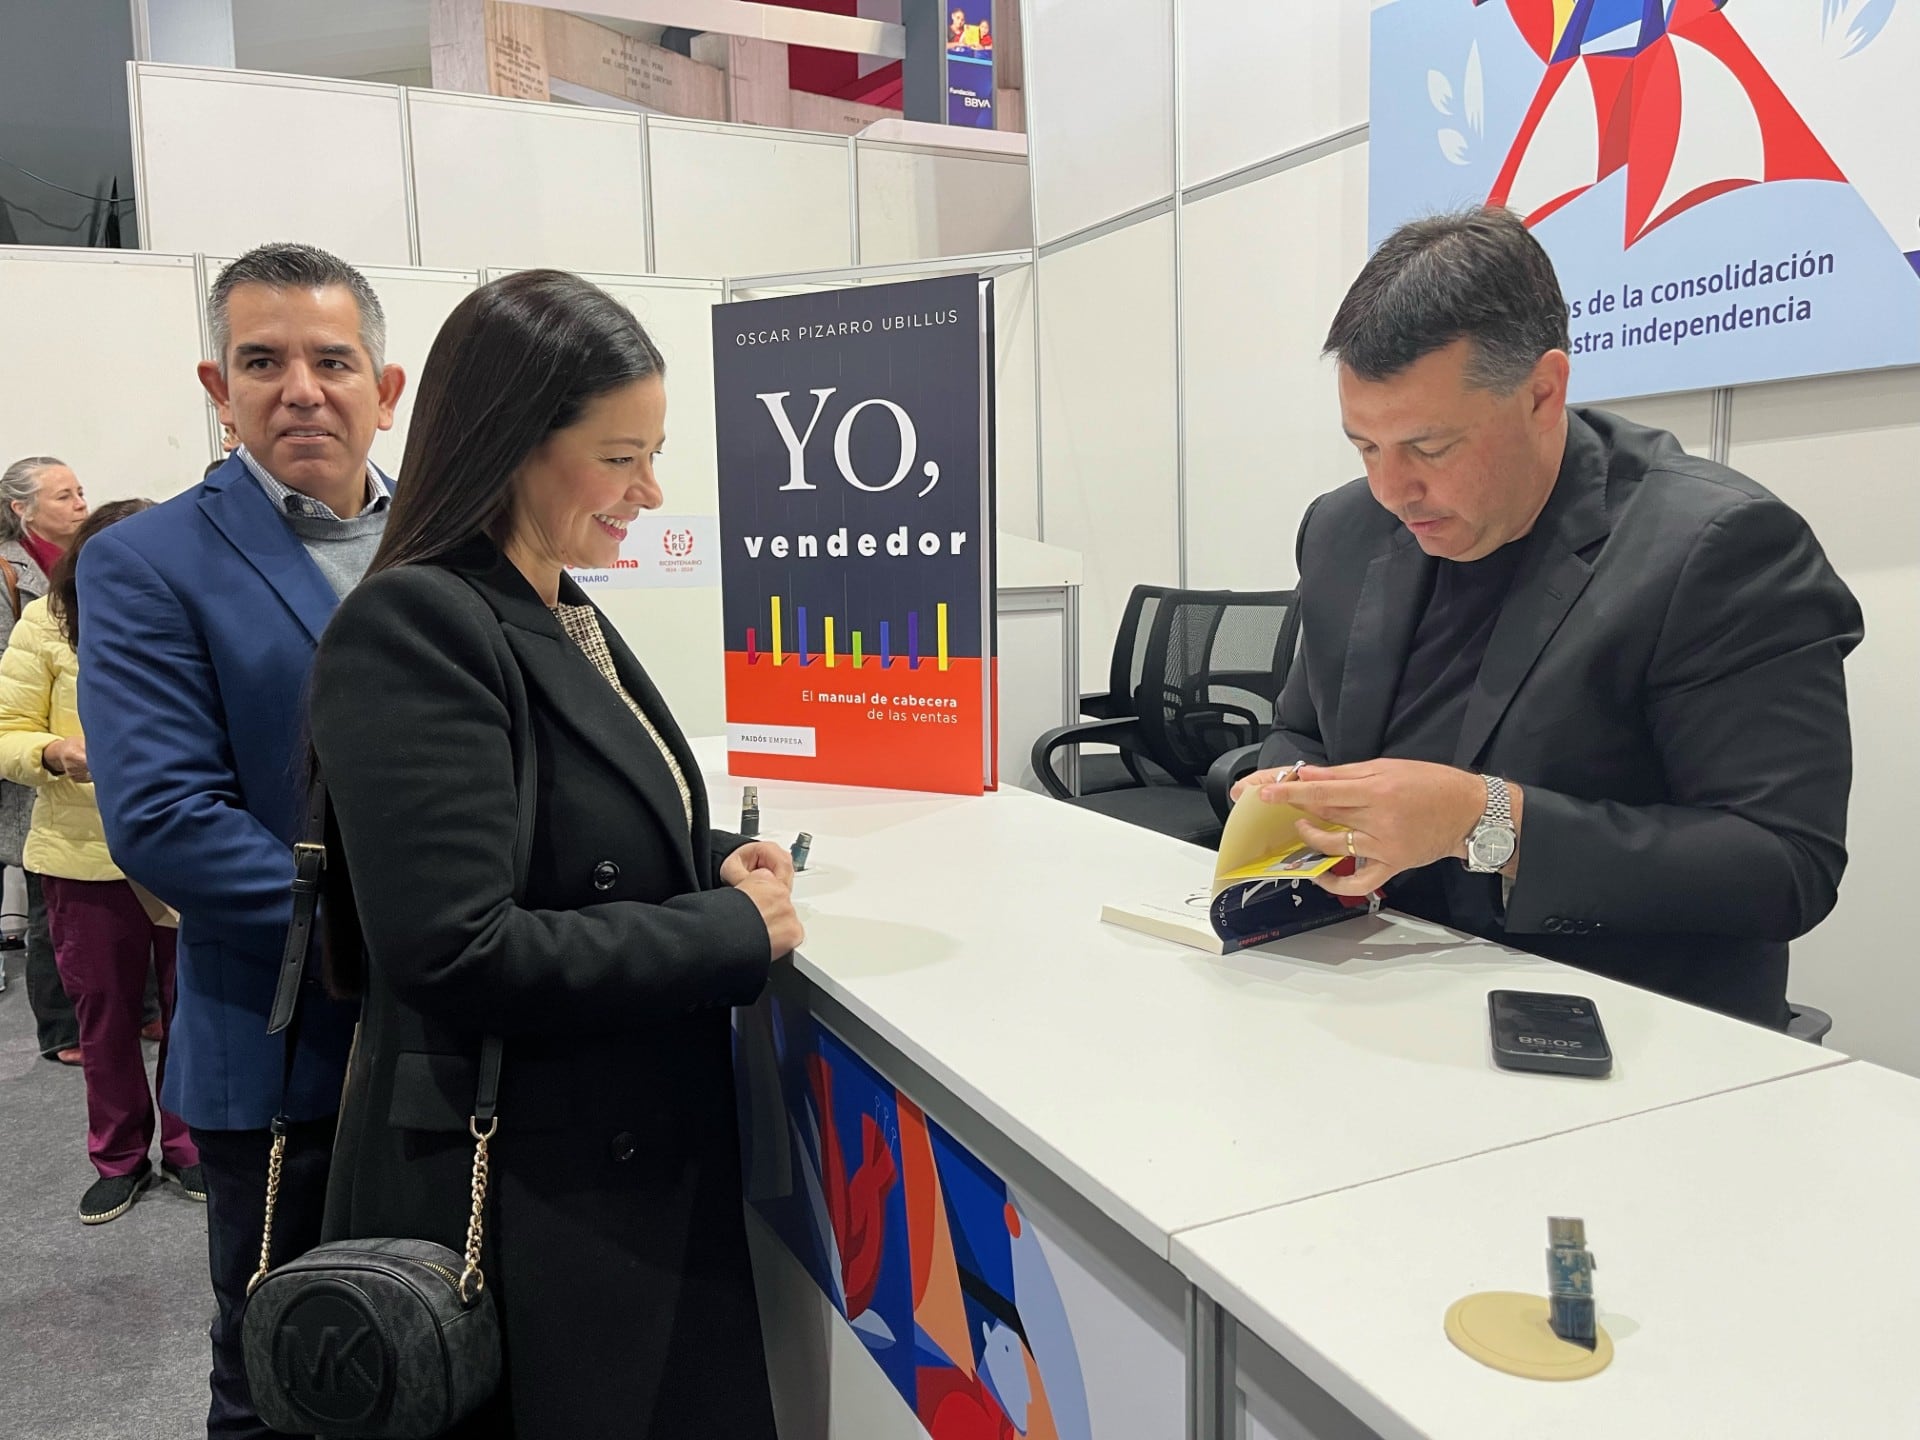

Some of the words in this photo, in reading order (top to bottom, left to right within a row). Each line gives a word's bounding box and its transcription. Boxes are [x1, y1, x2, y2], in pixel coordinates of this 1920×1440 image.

[964, 97, 991, 109] BBVA
[1588, 289, 1615, 315] de
[1623, 284, 1643, 309] la
[1651, 250, 1834, 304] consolidación
[736, 328, 790, 346] OSCAR
[799, 319, 873, 340] PIZARRO
[882, 309, 958, 331] UBILLUS
[1568, 331, 1613, 355] stra
[1622, 295, 1812, 347] independencia
[756, 387, 940, 498] YO,
[743, 525, 967, 558] vendedor
[572, 575, 609, 583] TENARIO
[802, 690, 813, 702] El
[818, 692, 866, 704] manual
[870, 692, 888, 705] de
[892, 694, 958, 708] cabecera
[867, 708, 884, 720] de
[888, 709, 907, 722] las
[912, 711, 958, 724] ventas
[741, 734, 767, 743] PAIDÓS
[768, 736, 803, 745] EMPRESA
[1518, 1036, 1583, 1049] 20:58
[279, 1325, 379, 1394] MK
